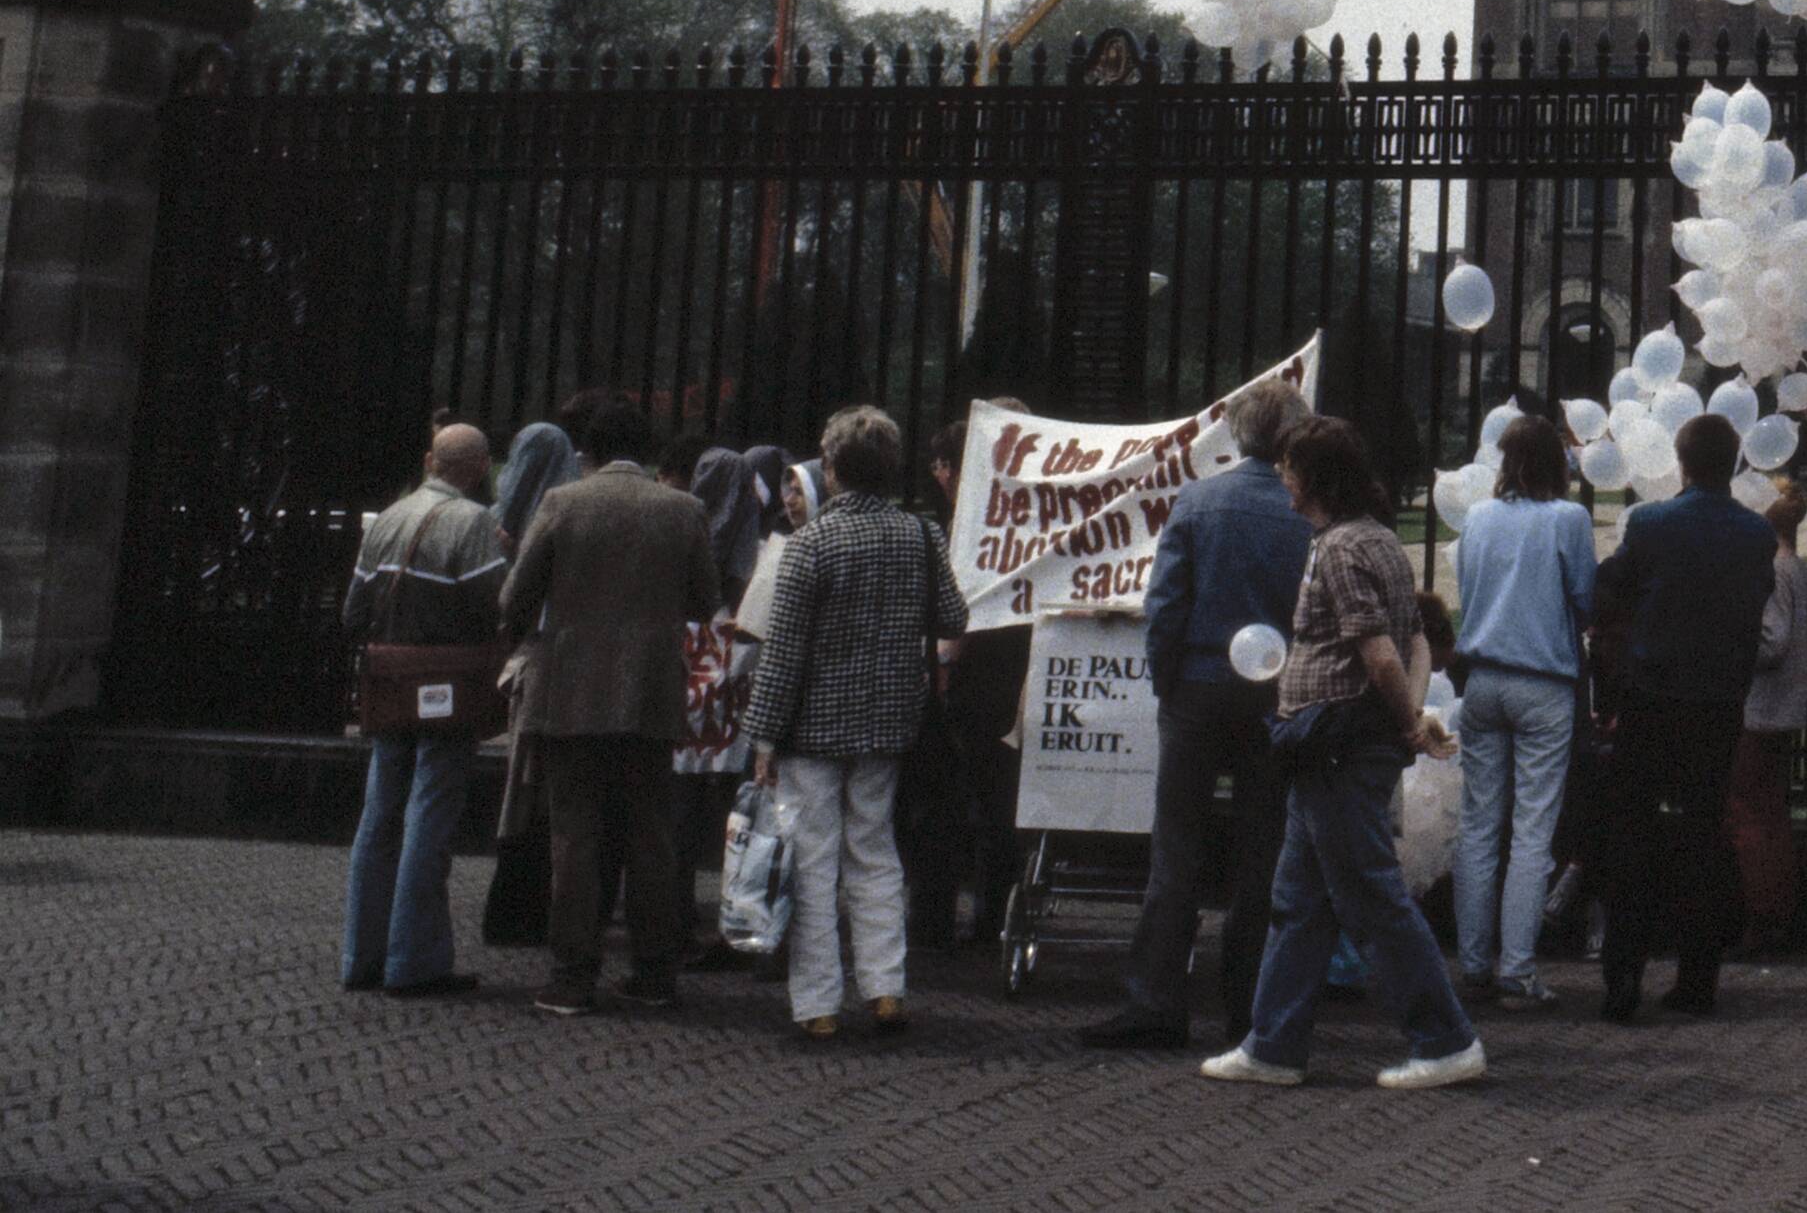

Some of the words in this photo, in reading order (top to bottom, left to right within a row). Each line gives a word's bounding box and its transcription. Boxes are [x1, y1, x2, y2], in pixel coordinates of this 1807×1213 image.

[992, 423, 1042, 477] If
[1041, 438, 1103, 477] the
[985, 477, 1031, 527] be
[1011, 578, 1033, 614] a
[1070, 556, 1153, 600] sacr
[1047, 657, 1082, 677] DE
[1045, 679, 1127, 700] ERIN..
[1042, 703, 1083, 727] IK
[1041, 731, 1131, 753] ERUIT.
